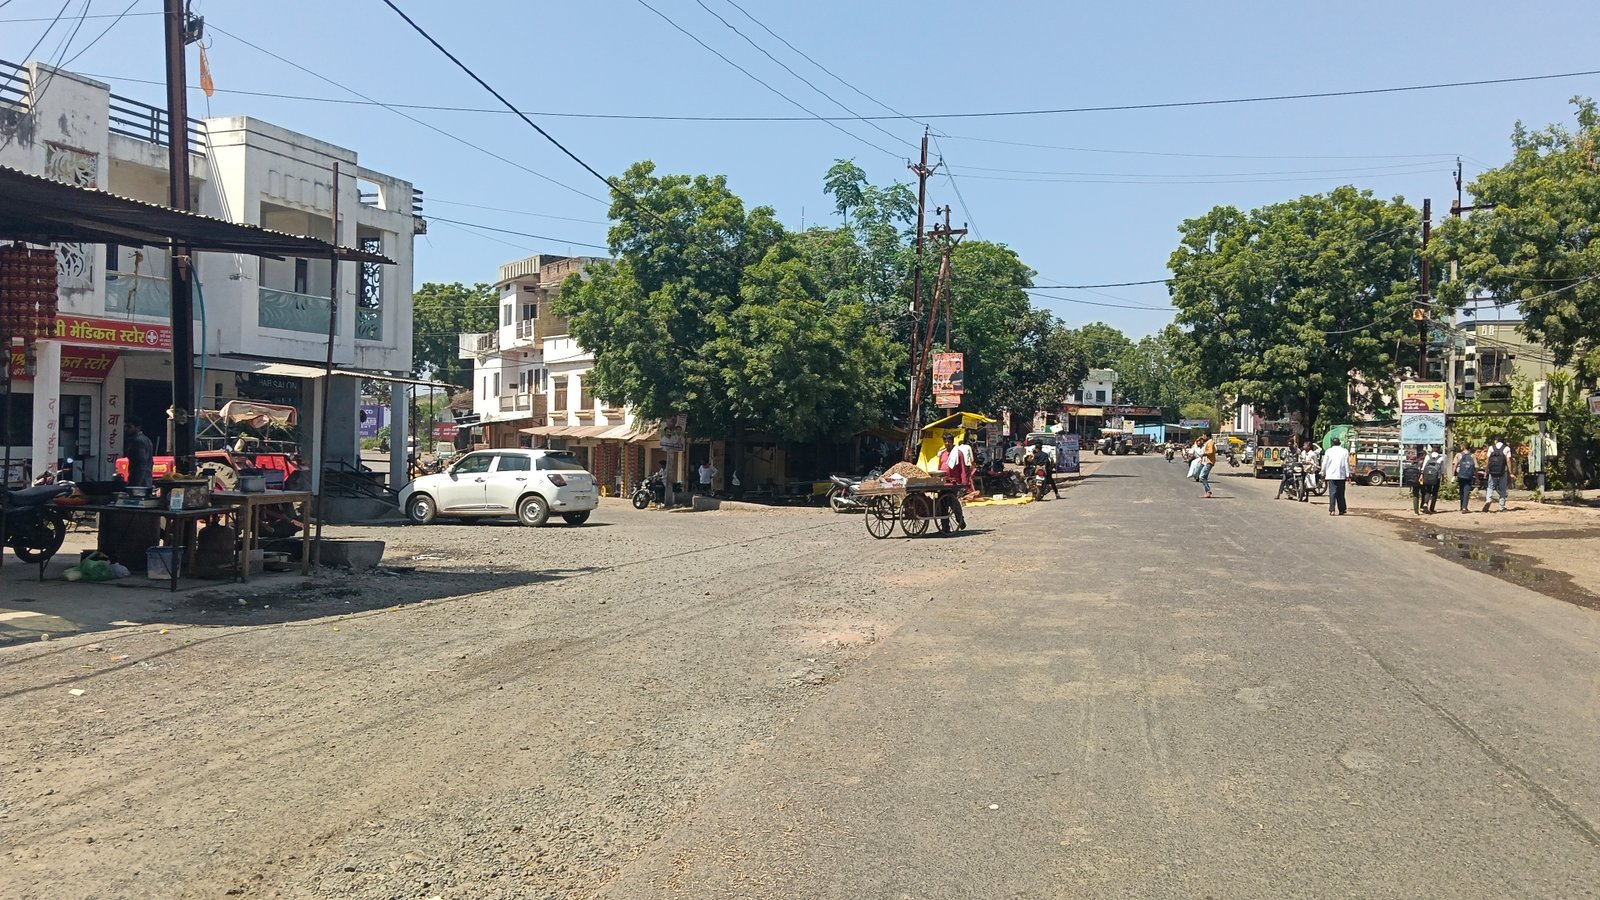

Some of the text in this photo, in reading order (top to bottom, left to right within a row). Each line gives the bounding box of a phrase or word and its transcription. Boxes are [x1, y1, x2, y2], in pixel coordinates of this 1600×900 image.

[70, 320, 116, 341] मेडिकल
[120, 326, 145, 344] स्टोर
[85, 354, 111, 370] स्टोर
